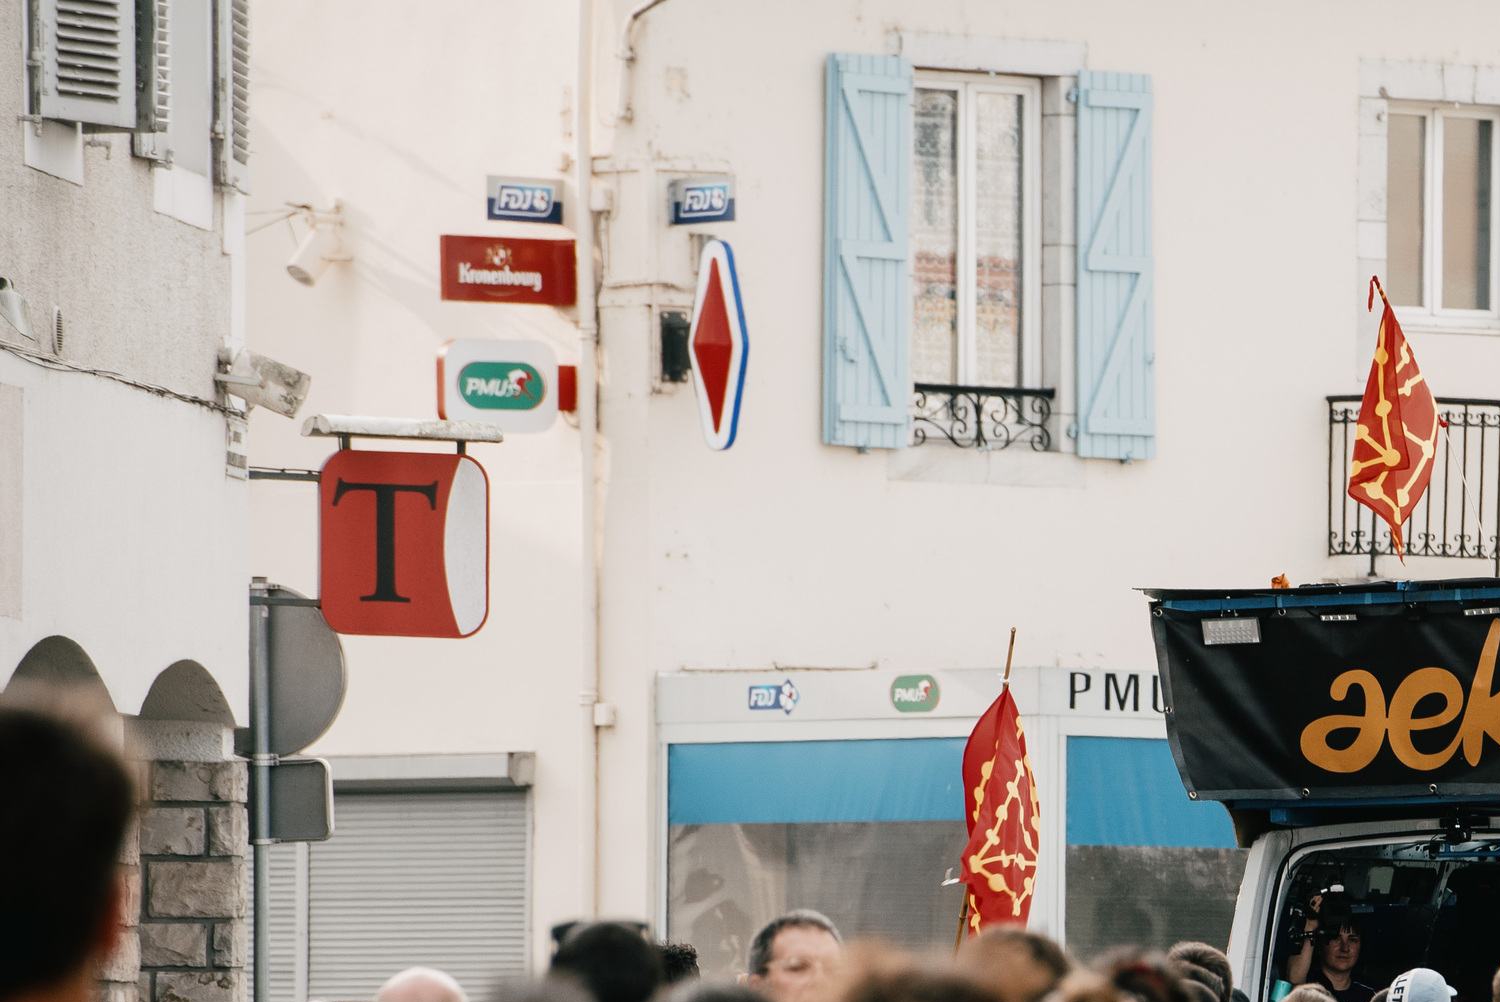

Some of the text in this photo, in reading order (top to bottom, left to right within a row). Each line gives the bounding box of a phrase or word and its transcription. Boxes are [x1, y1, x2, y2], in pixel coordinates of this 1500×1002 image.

[499, 190, 534, 211] FDJ
[684, 190, 714, 211] FDJ
[458, 262, 542, 292] Kronenbourg
[465, 376, 509, 397] PMU
[331, 477, 439, 604] T
[750, 688, 777, 707] FDJ
[893, 687, 919, 703] PMU
